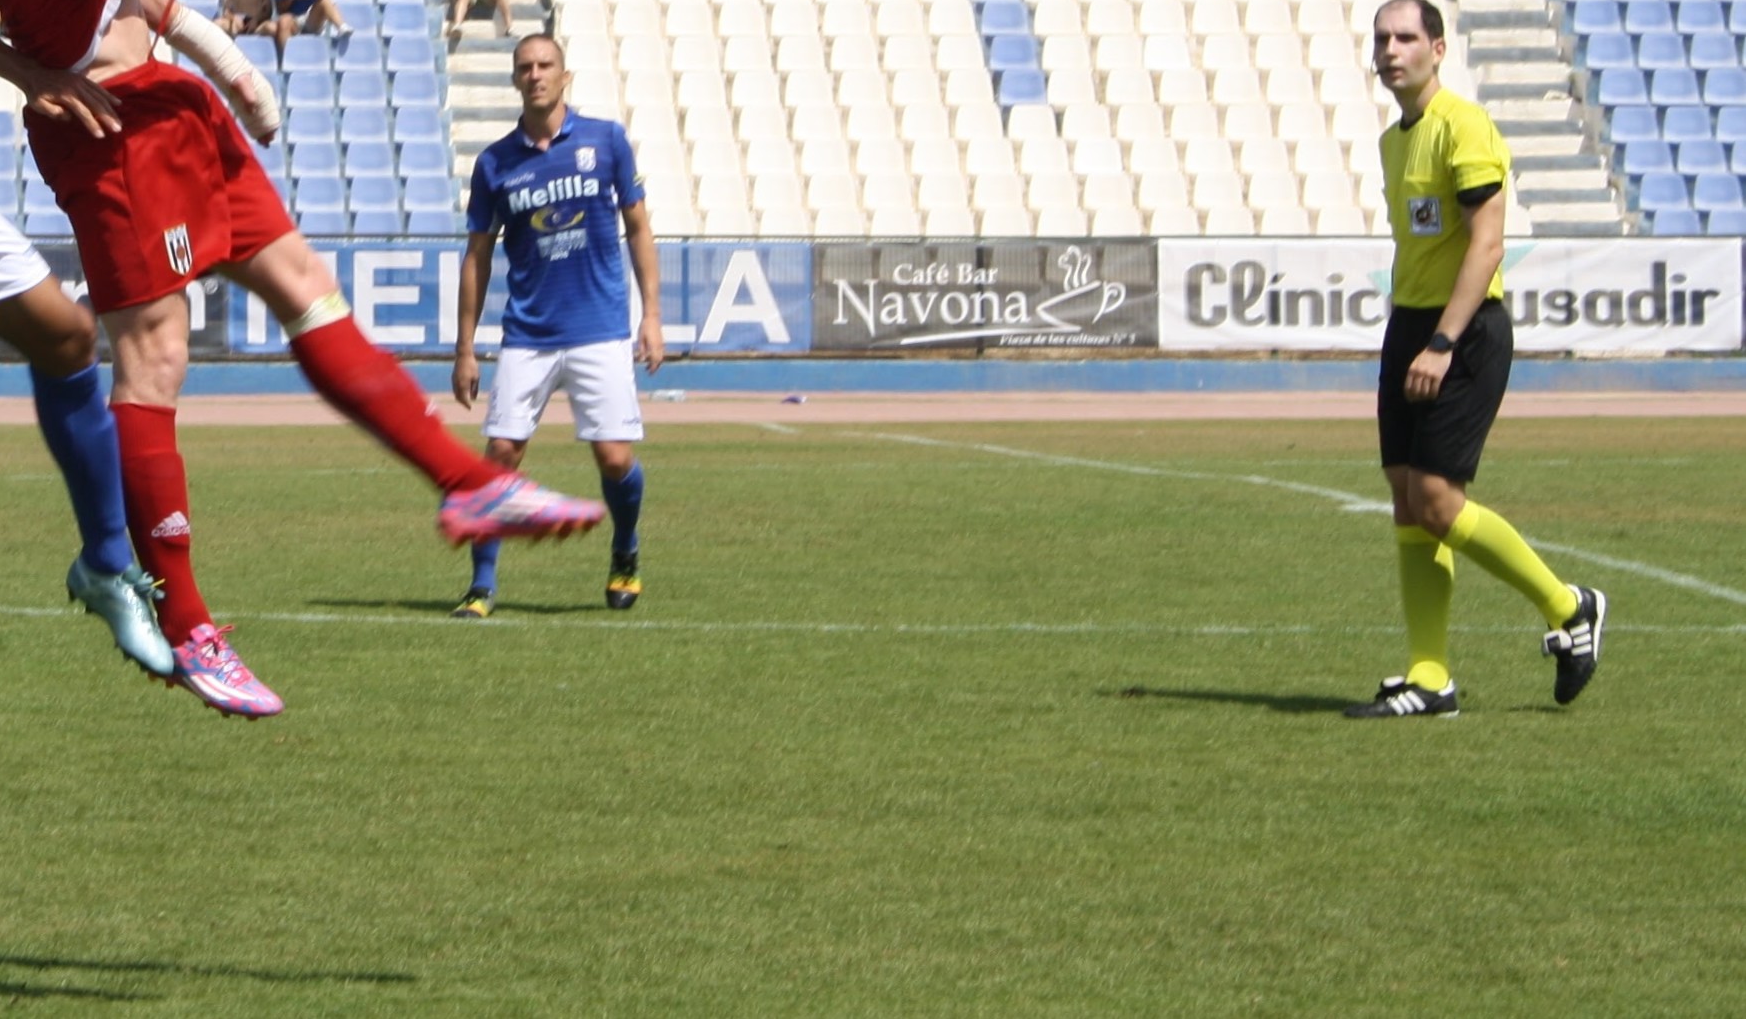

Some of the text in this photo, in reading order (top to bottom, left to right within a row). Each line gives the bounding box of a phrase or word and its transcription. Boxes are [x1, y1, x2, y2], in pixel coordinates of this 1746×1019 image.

[508, 174, 600, 215] Melilla
[893, 261, 999, 286] Café Bar
[1184, 260, 1722, 329] Clínic usadir
[833, 278, 1032, 338] Navona
